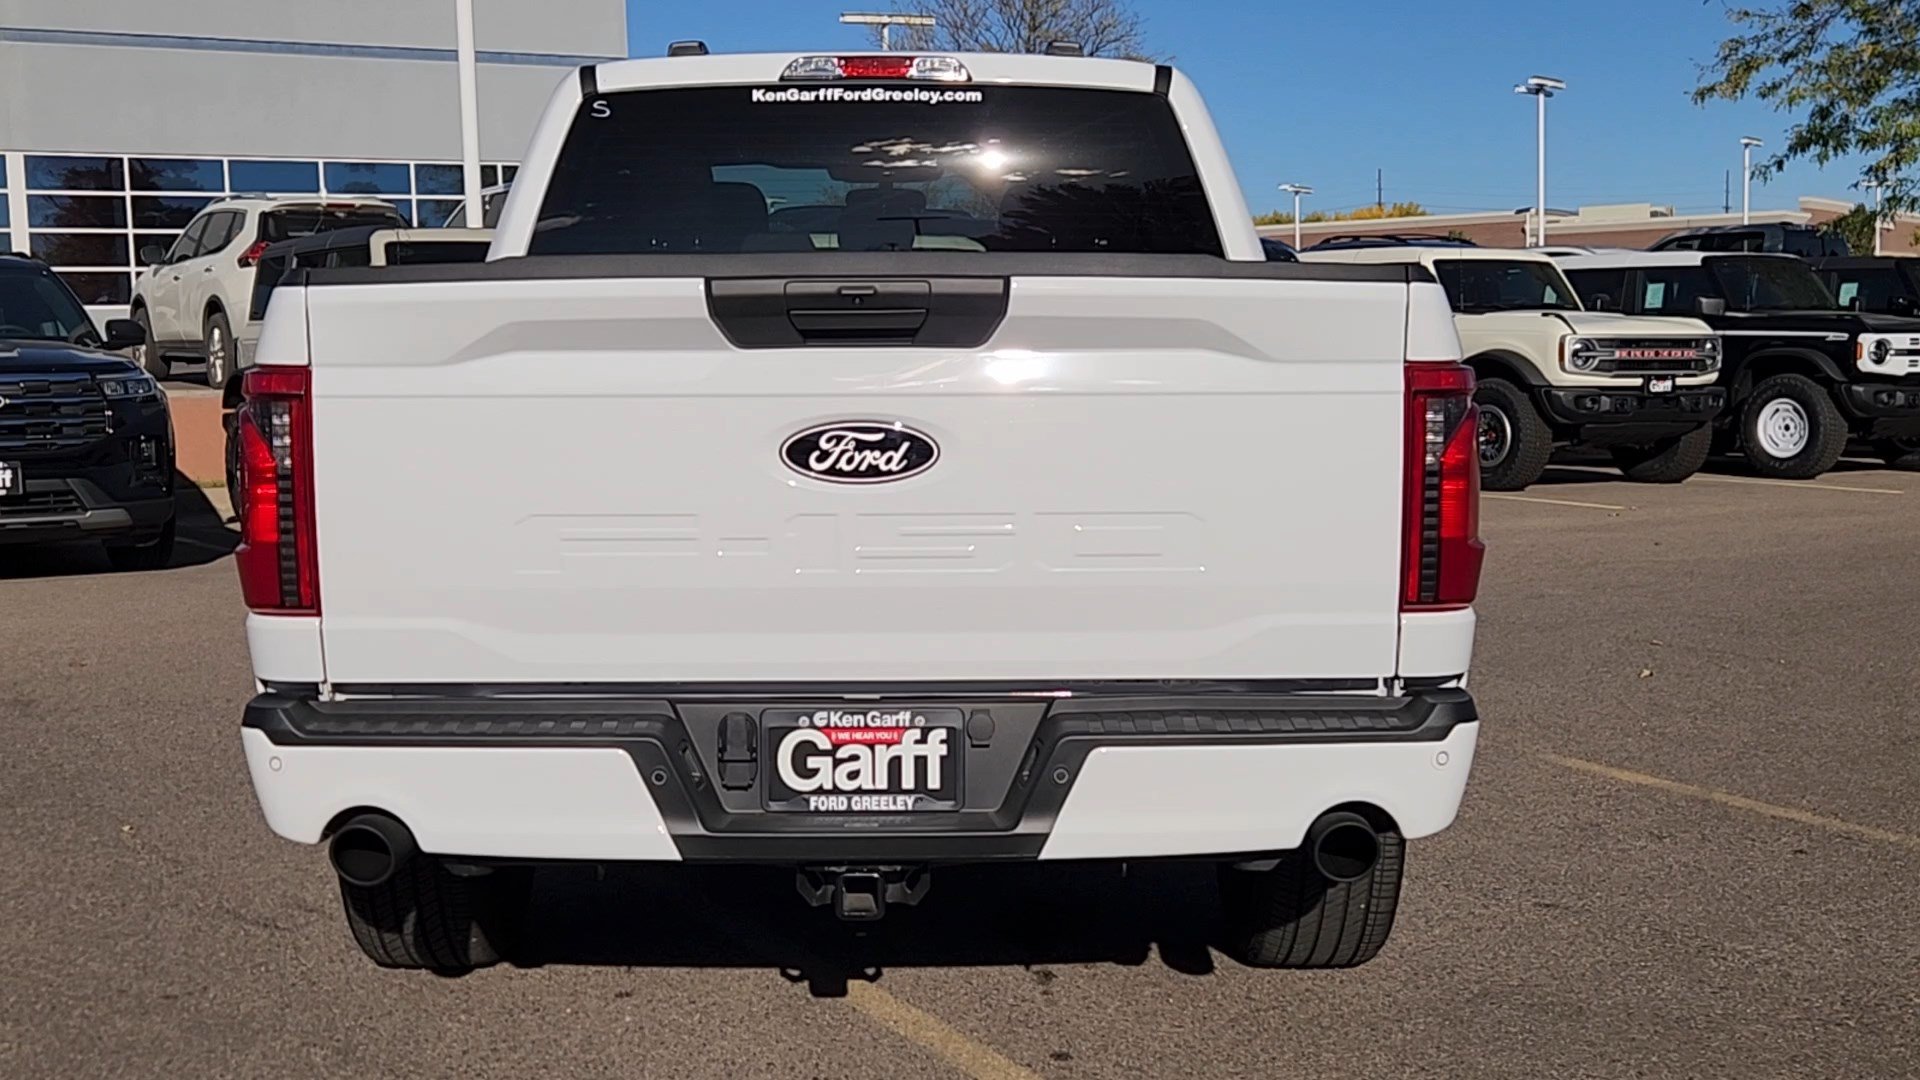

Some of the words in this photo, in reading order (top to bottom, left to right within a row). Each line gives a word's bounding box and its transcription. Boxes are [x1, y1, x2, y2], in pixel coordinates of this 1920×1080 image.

[751, 88, 983, 104] KenGarffFordGreeley.com
[591, 100, 611, 117] S
[808, 430, 911, 472] Ford
[830, 711, 864, 727] Ken
[866, 711, 911, 727] Garff
[837, 731, 851, 741] WE
[852, 731, 874, 741] HEAR
[875, 731, 892, 741] YOU
[777, 728, 948, 791] Garff
[809, 796, 848, 811] FORD
[851, 796, 915, 811] GREELEY
